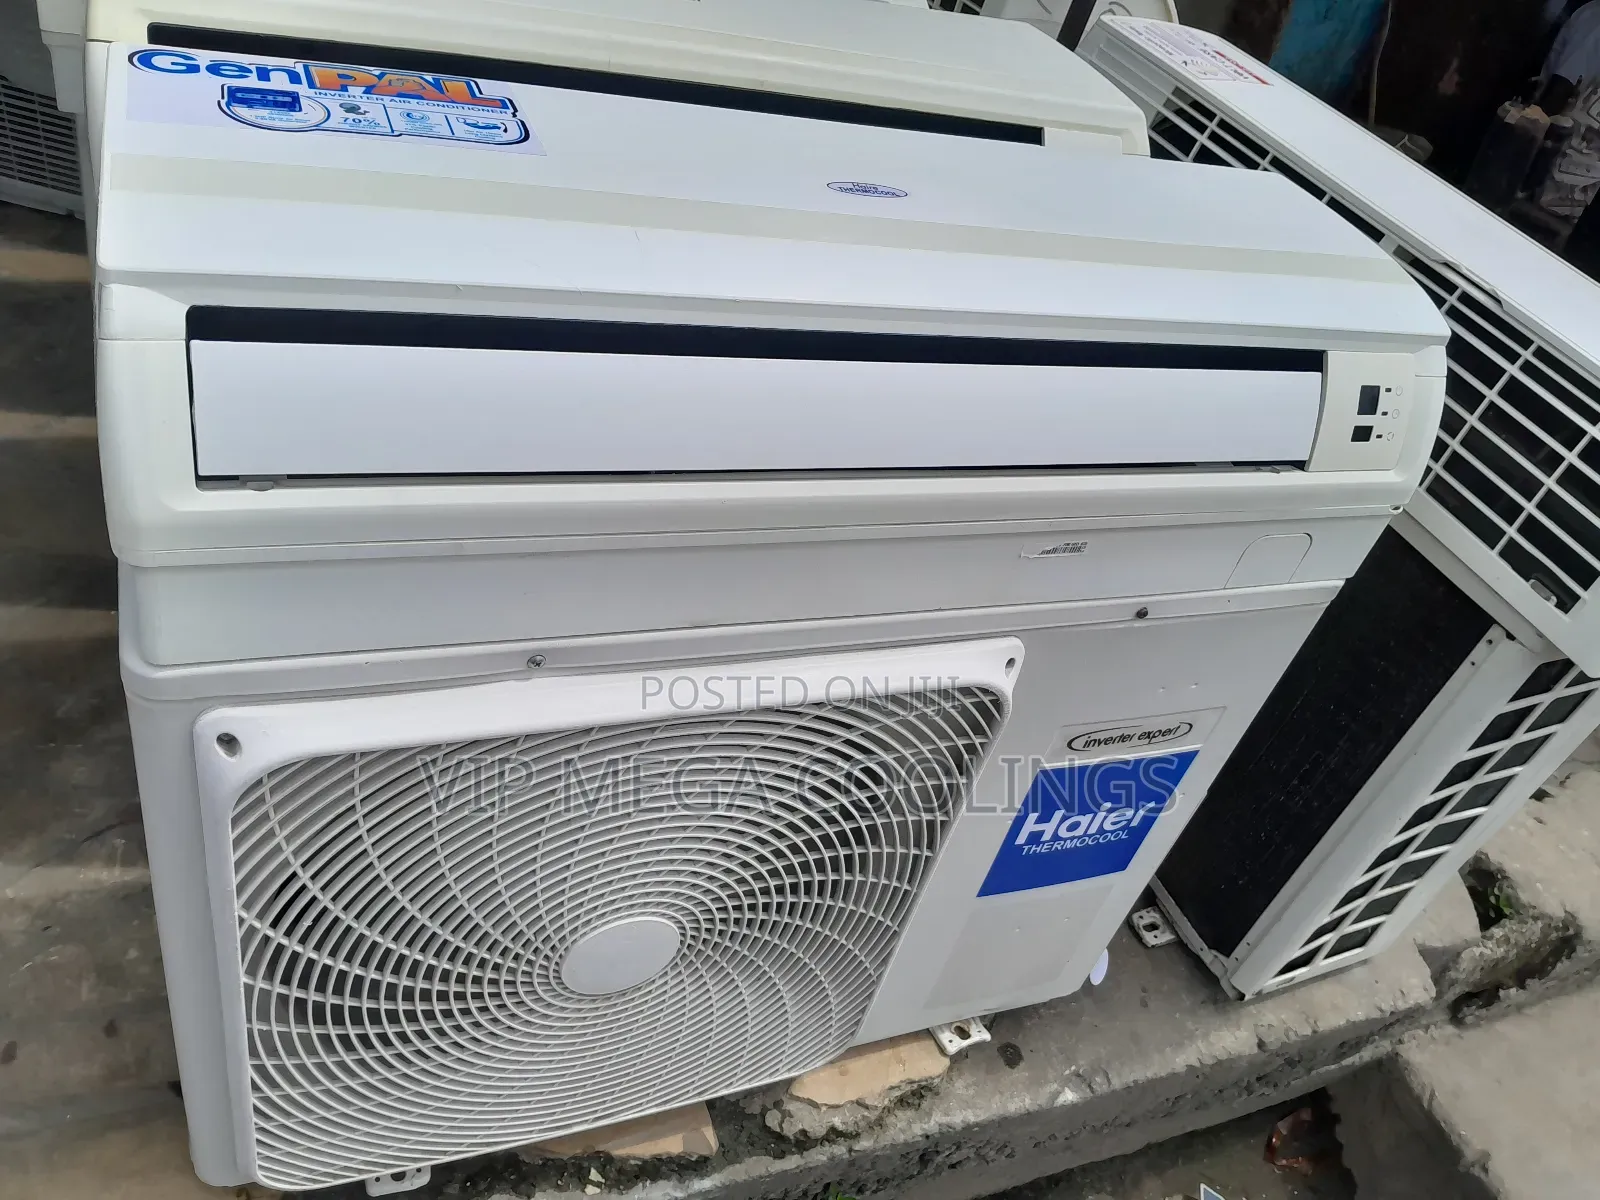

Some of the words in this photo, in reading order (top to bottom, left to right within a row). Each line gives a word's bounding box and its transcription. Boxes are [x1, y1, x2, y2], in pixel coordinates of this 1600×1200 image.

[314, 91, 386, 102] INVERTER
[417, 101, 508, 115] CONDITIONER
[340, 117, 381, 126] 70%
[1082, 732, 1136, 749] inverter
[1137, 723, 1182, 744] expert
[1014, 801, 1156, 845] Haier
[1021, 829, 1130, 856] THERMOCOOL
